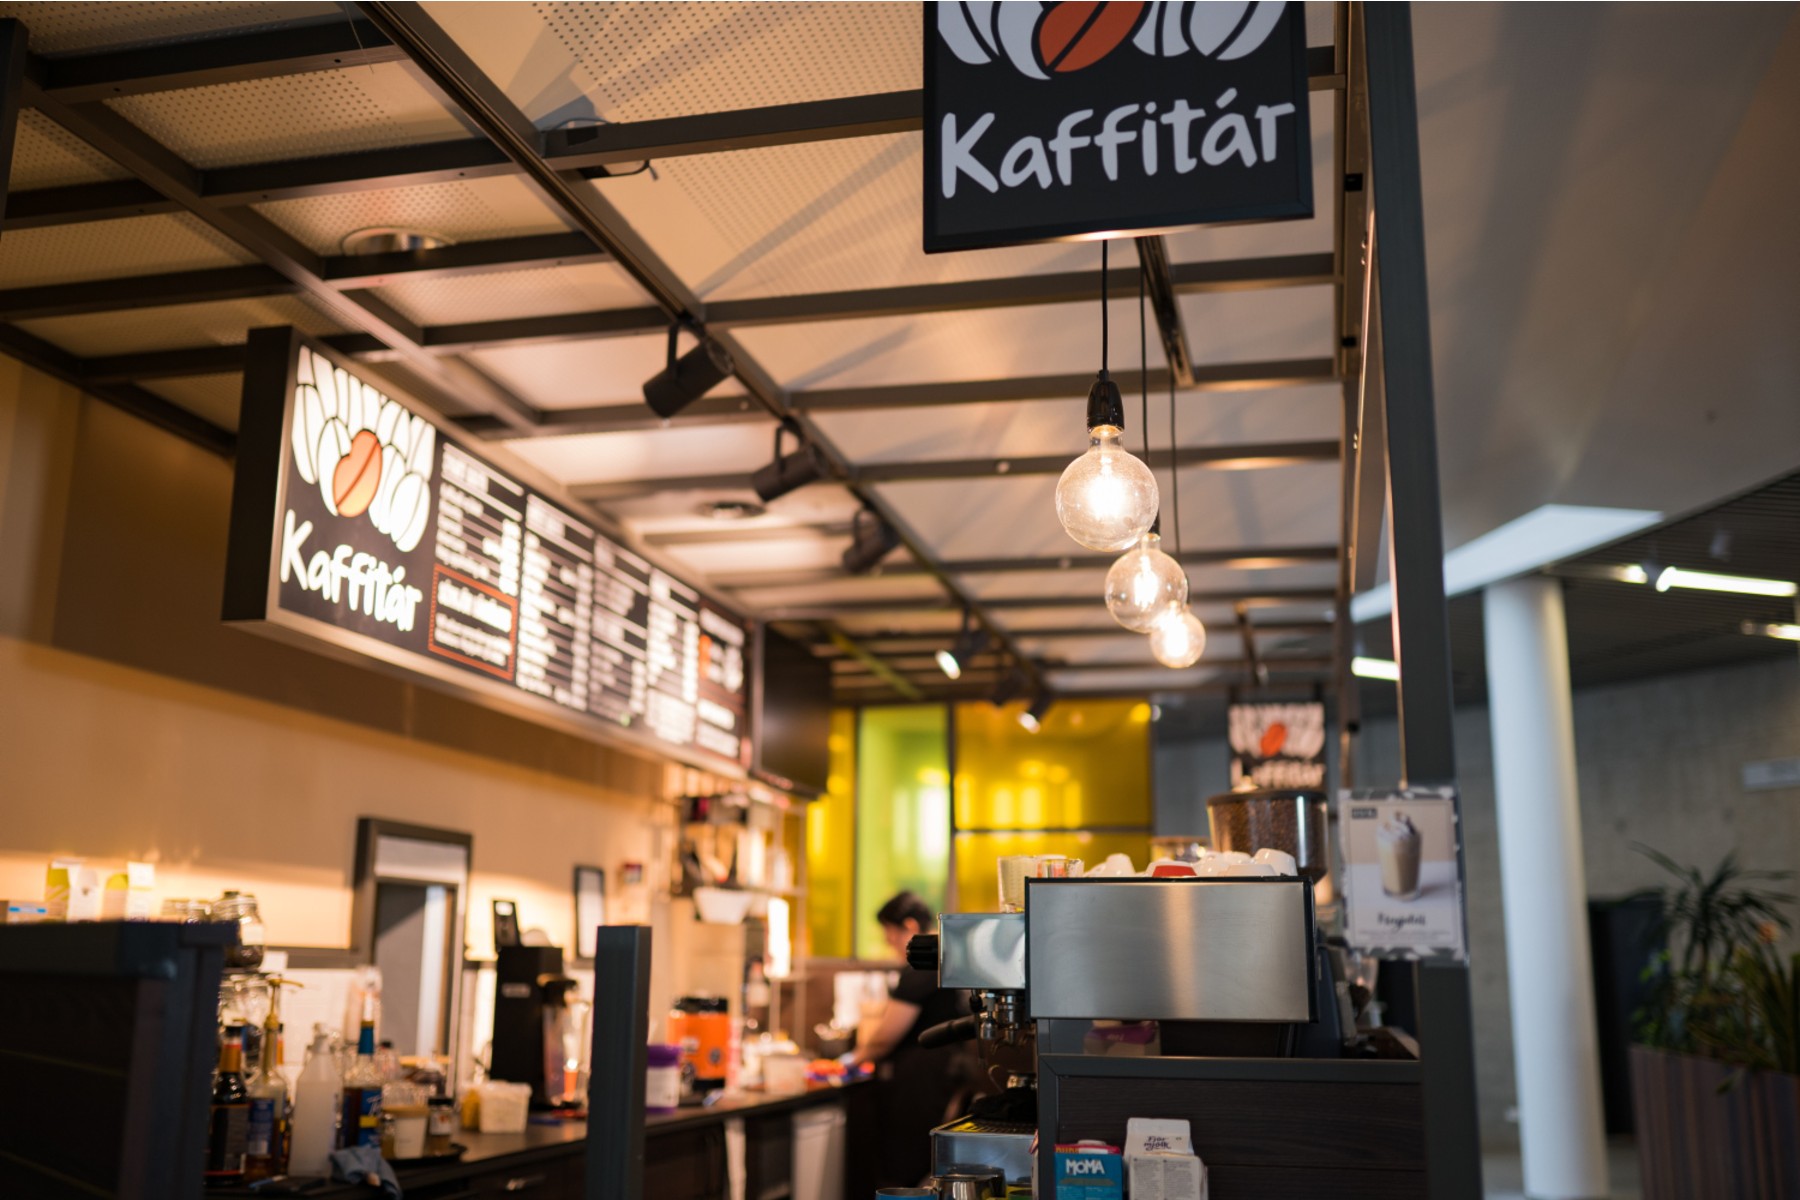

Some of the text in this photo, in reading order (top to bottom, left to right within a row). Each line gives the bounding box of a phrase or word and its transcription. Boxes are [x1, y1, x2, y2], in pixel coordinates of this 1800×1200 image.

[941, 88, 1295, 199] Kaffitár
[280, 508, 424, 632] Kaffitár
[1065, 1158, 1105, 1176] MOMA
